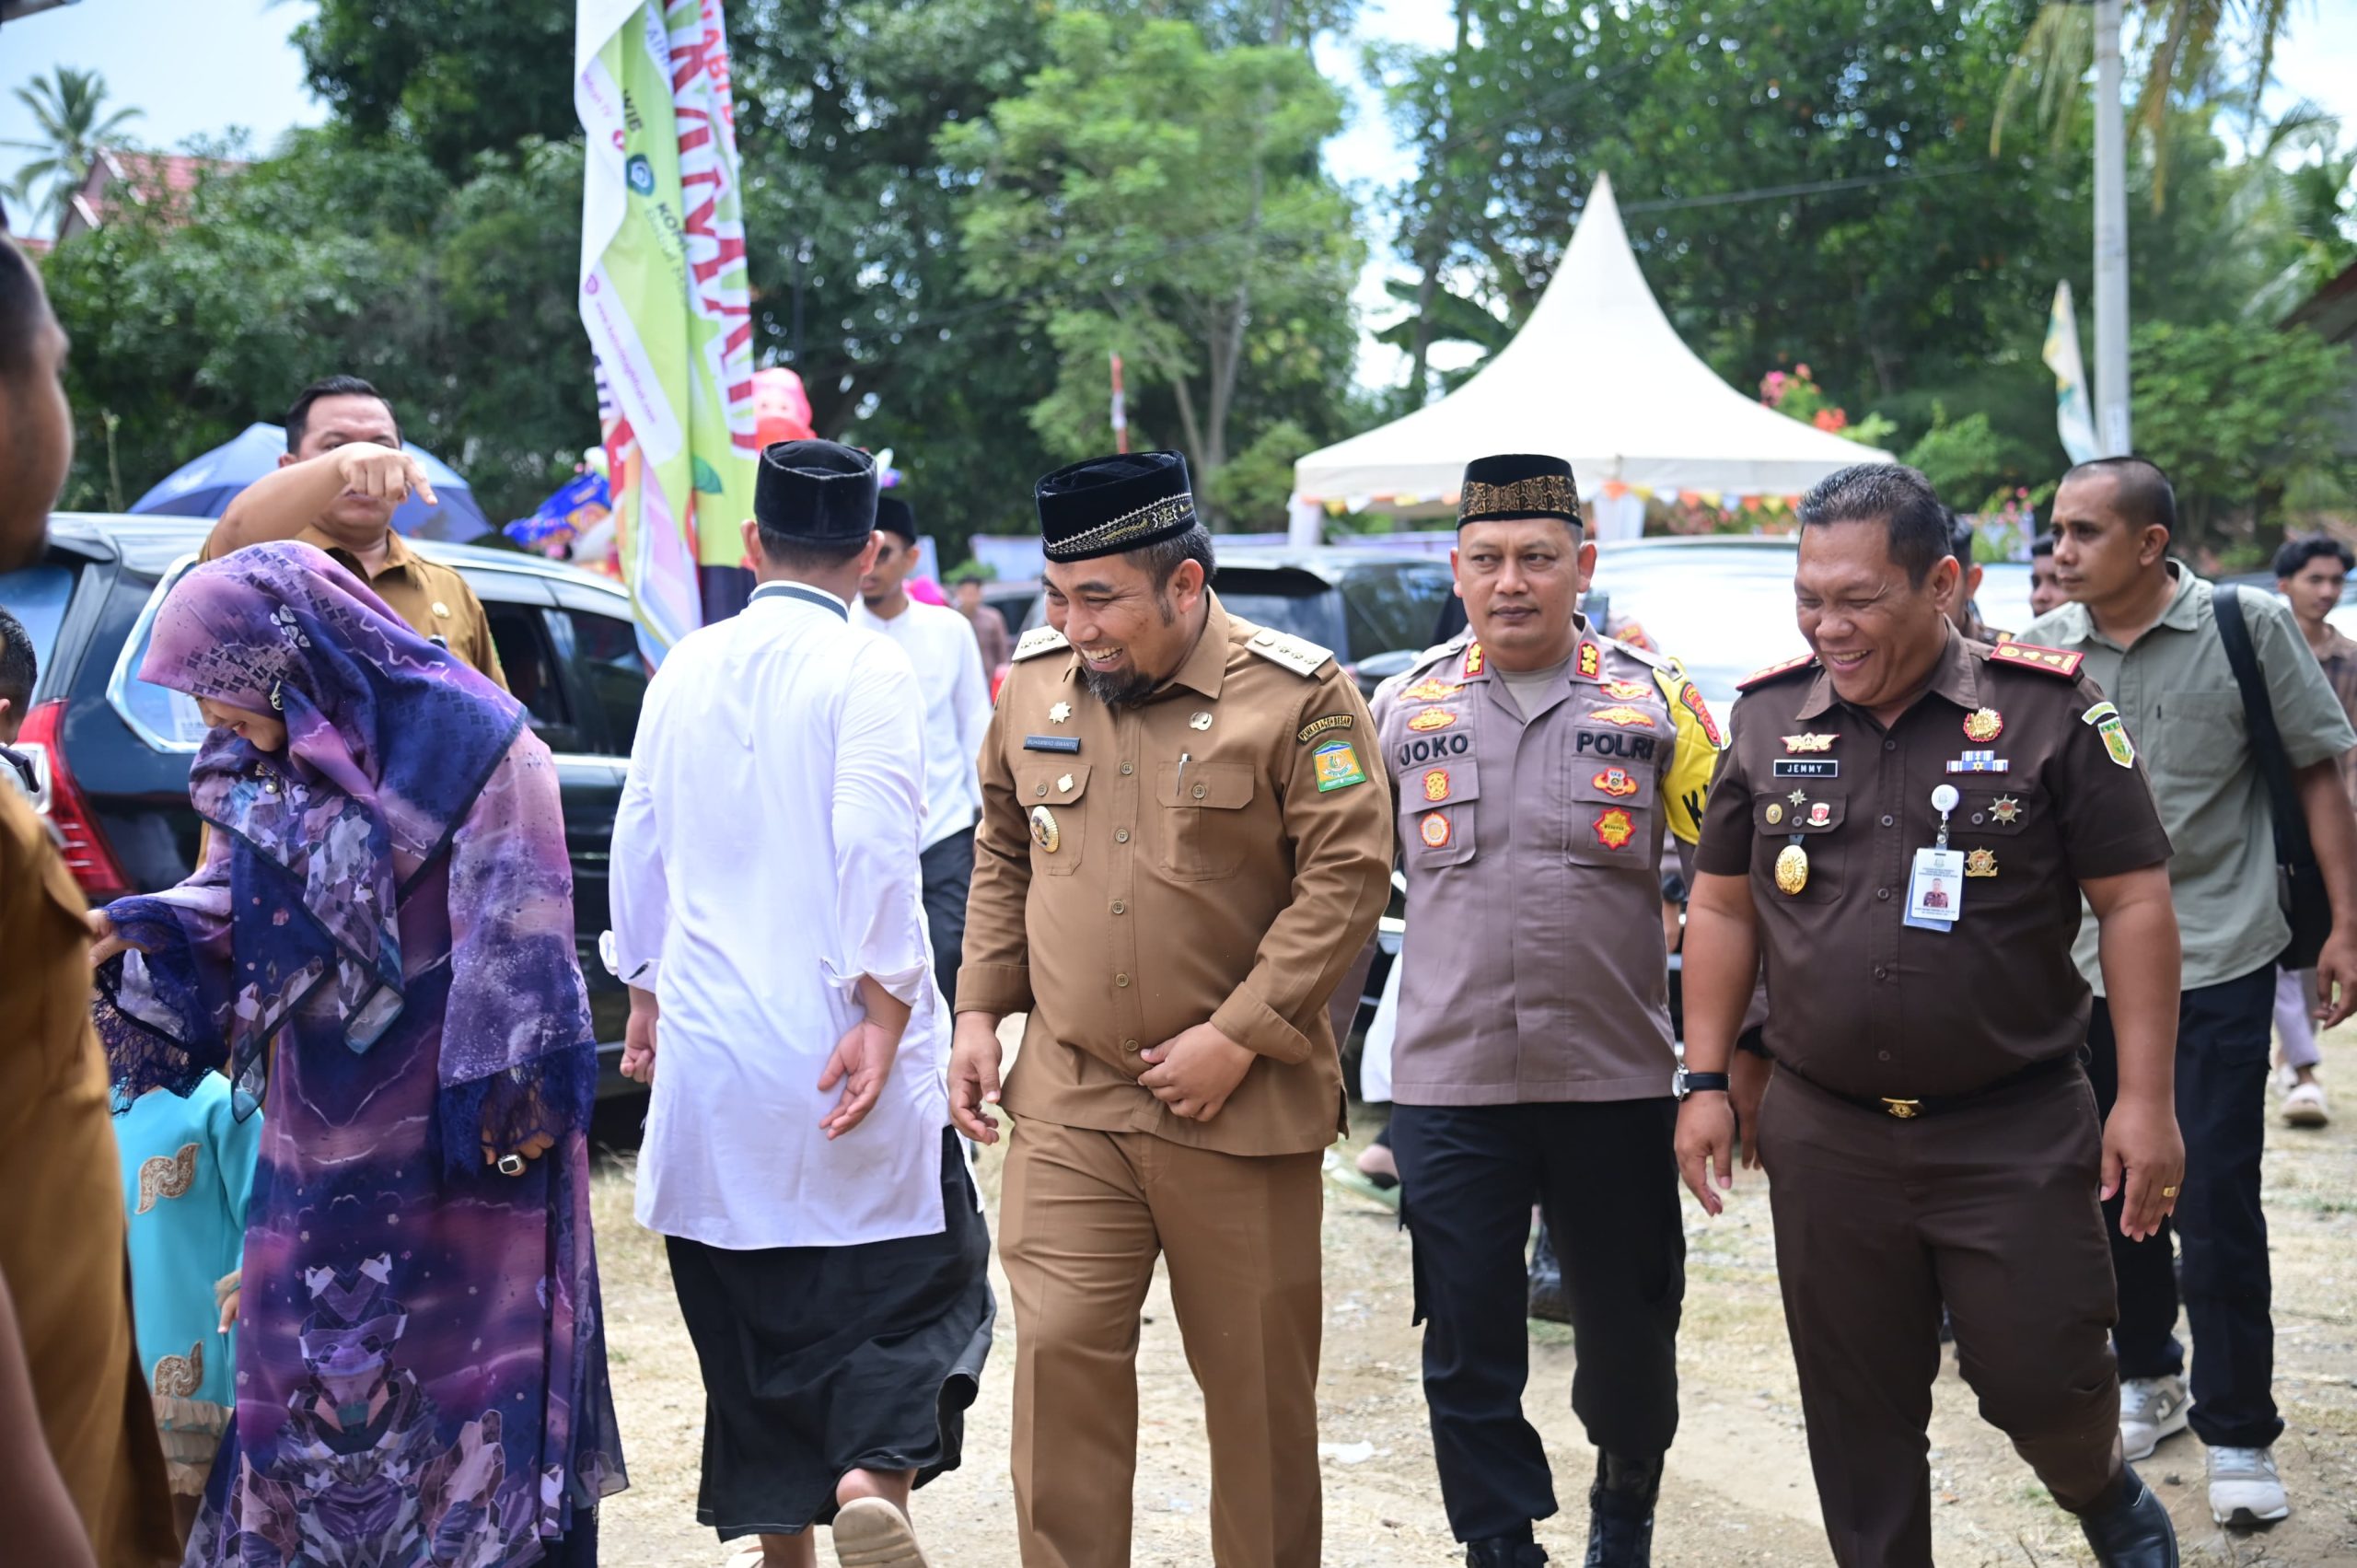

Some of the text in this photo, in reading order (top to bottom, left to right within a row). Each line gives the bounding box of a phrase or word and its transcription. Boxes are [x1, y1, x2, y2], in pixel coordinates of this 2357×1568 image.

[1333, 716, 1351, 726] BESAR
[1400, 734, 1468, 765] JOKO
[1576, 730, 1655, 760] POLRI
[1787, 764, 1822, 773] JEMMY
